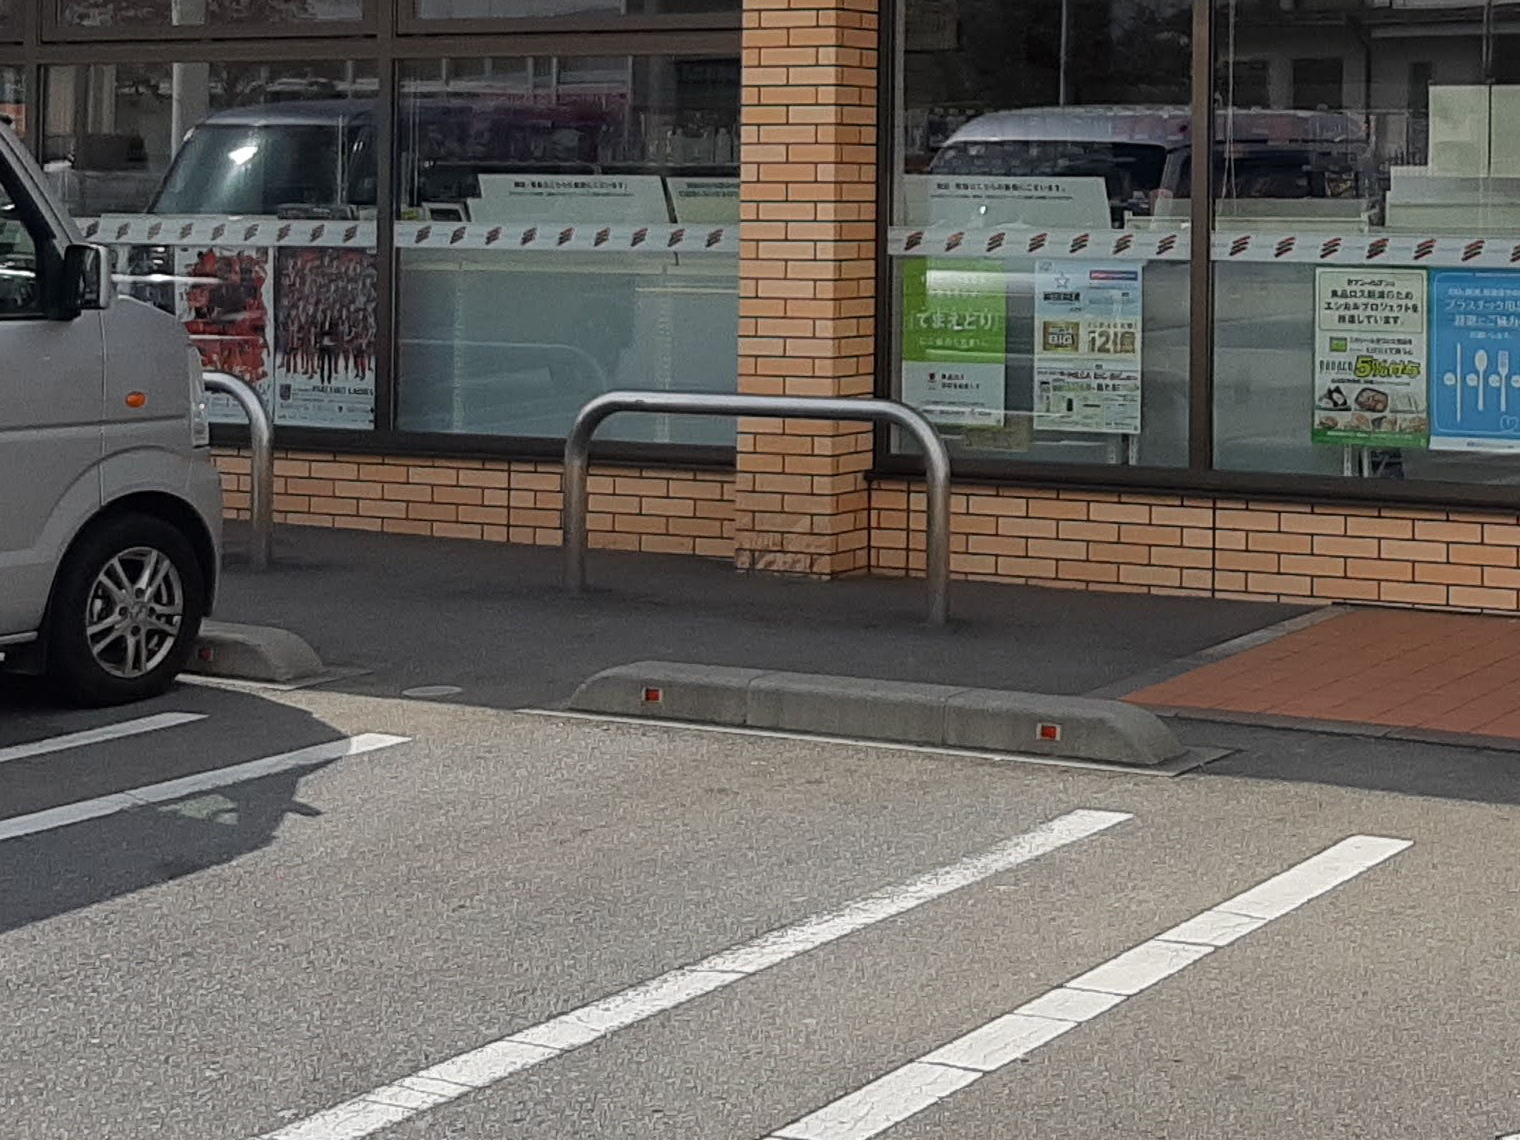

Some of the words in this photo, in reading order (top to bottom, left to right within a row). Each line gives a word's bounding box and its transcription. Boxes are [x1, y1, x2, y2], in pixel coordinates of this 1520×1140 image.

[917, 308, 992, 330] てまえどり
